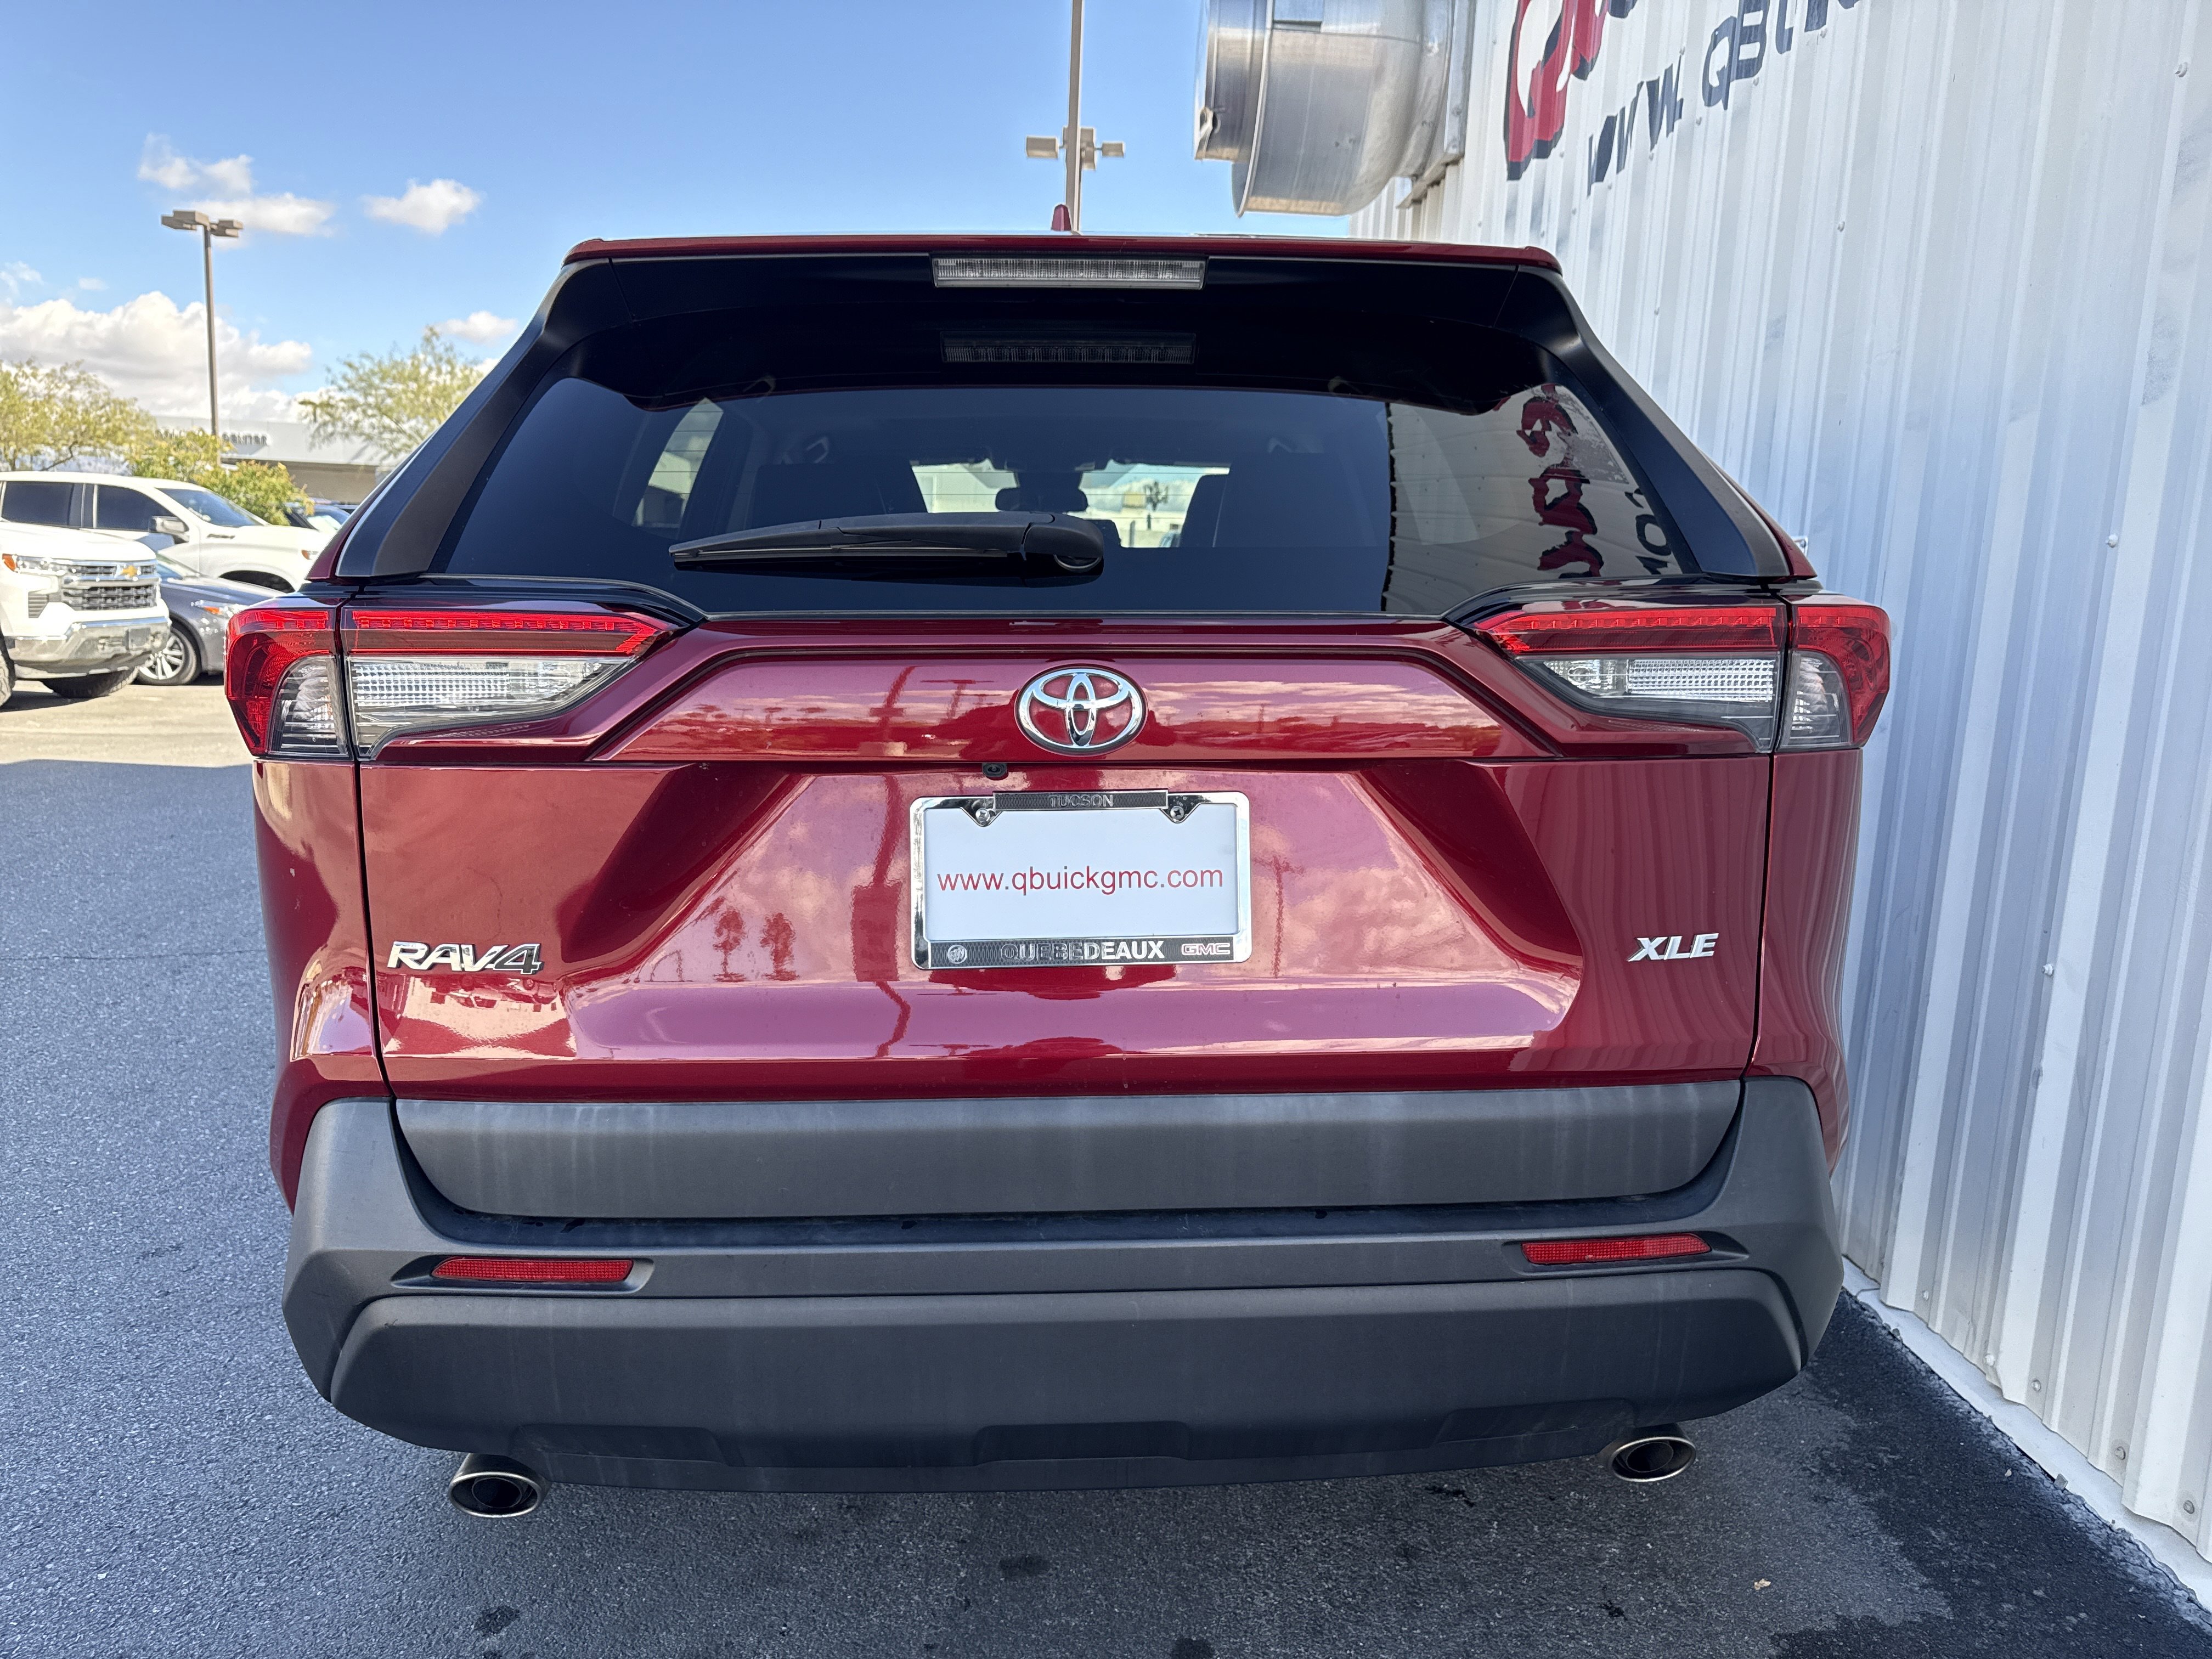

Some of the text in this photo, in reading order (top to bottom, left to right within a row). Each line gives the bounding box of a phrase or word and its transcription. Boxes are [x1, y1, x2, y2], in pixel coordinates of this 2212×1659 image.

[1049, 794, 1114, 808] TUCSON
[937, 866, 1223, 896] www.qbuickgmc.com
[387, 941, 544, 975] RAV4
[1000, 940, 1232, 963] QUEBEDEAUX GMC
[1627, 932, 1719, 962] XLE
